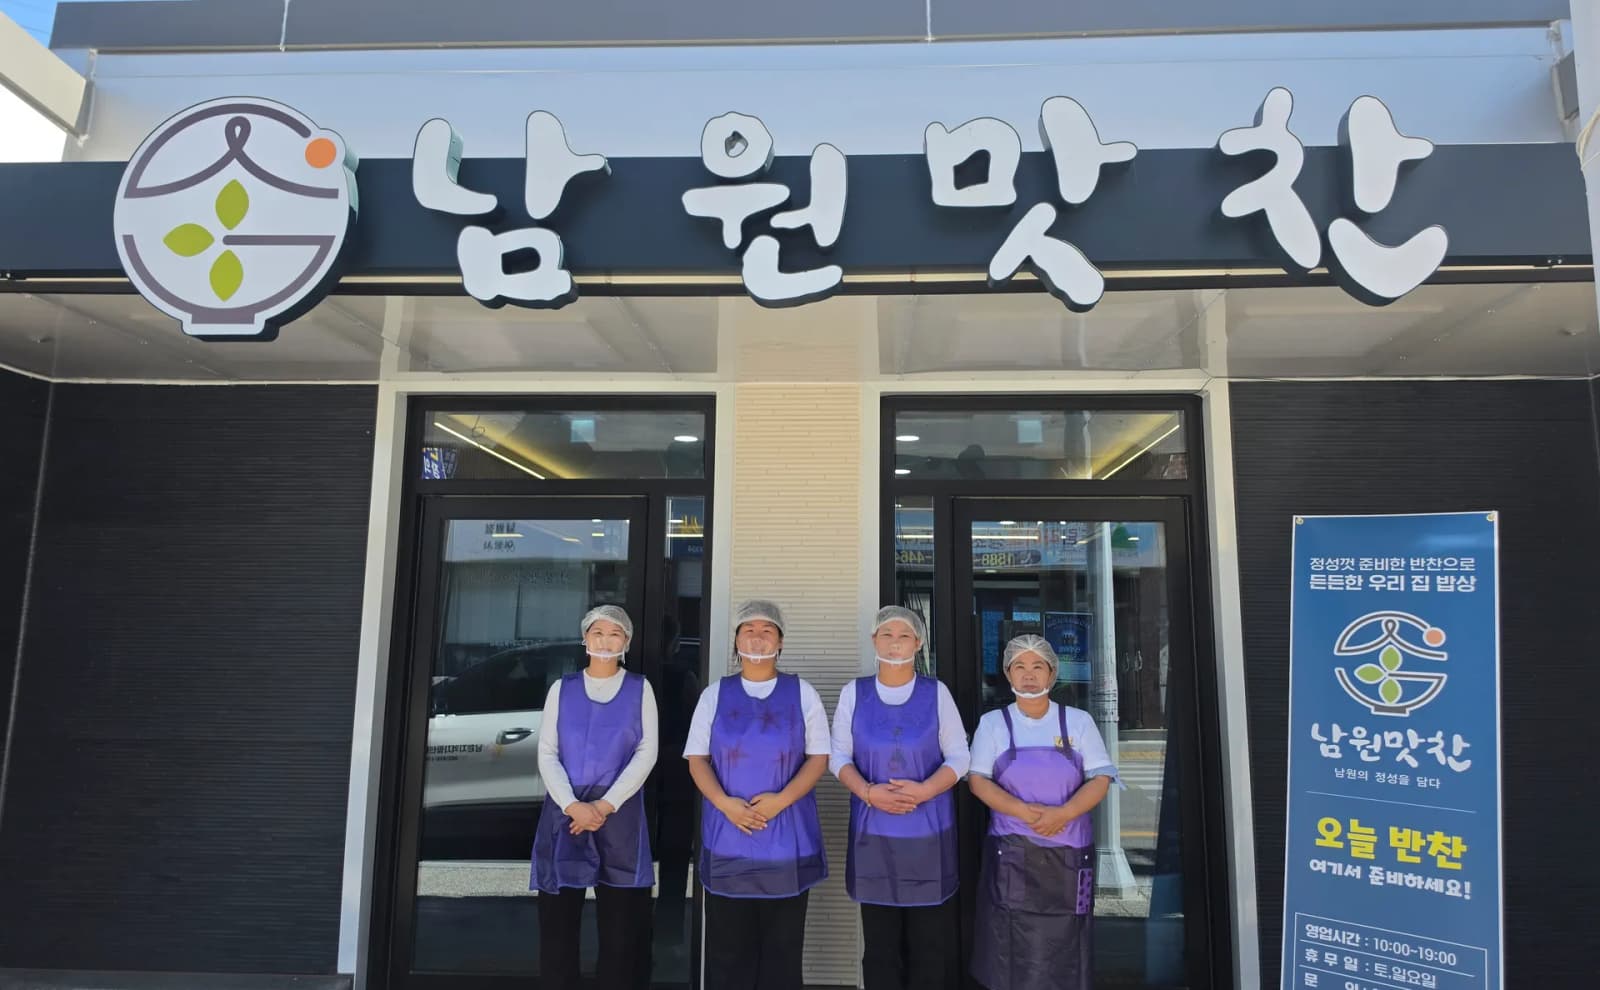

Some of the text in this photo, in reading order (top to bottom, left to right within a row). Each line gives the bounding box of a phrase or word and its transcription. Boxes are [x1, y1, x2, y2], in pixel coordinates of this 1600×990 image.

[1309, 574, 1477, 593] 든든한 우리 집 밥상
[1310, 557, 1476, 572] 정성껏 준비한 반찬으로
[1311, 723, 1472, 772] 남원맛찬
[1334, 767, 1441, 789] 남원의 정성을 담다
[1315, 816, 1468, 870] 오늘 반찬
[1309, 858, 1472, 900] 여기서 준비하세요!
[1304, 923, 1361, 947] 영업시간
[1373, 937, 1457, 966] 10:00~19:00
